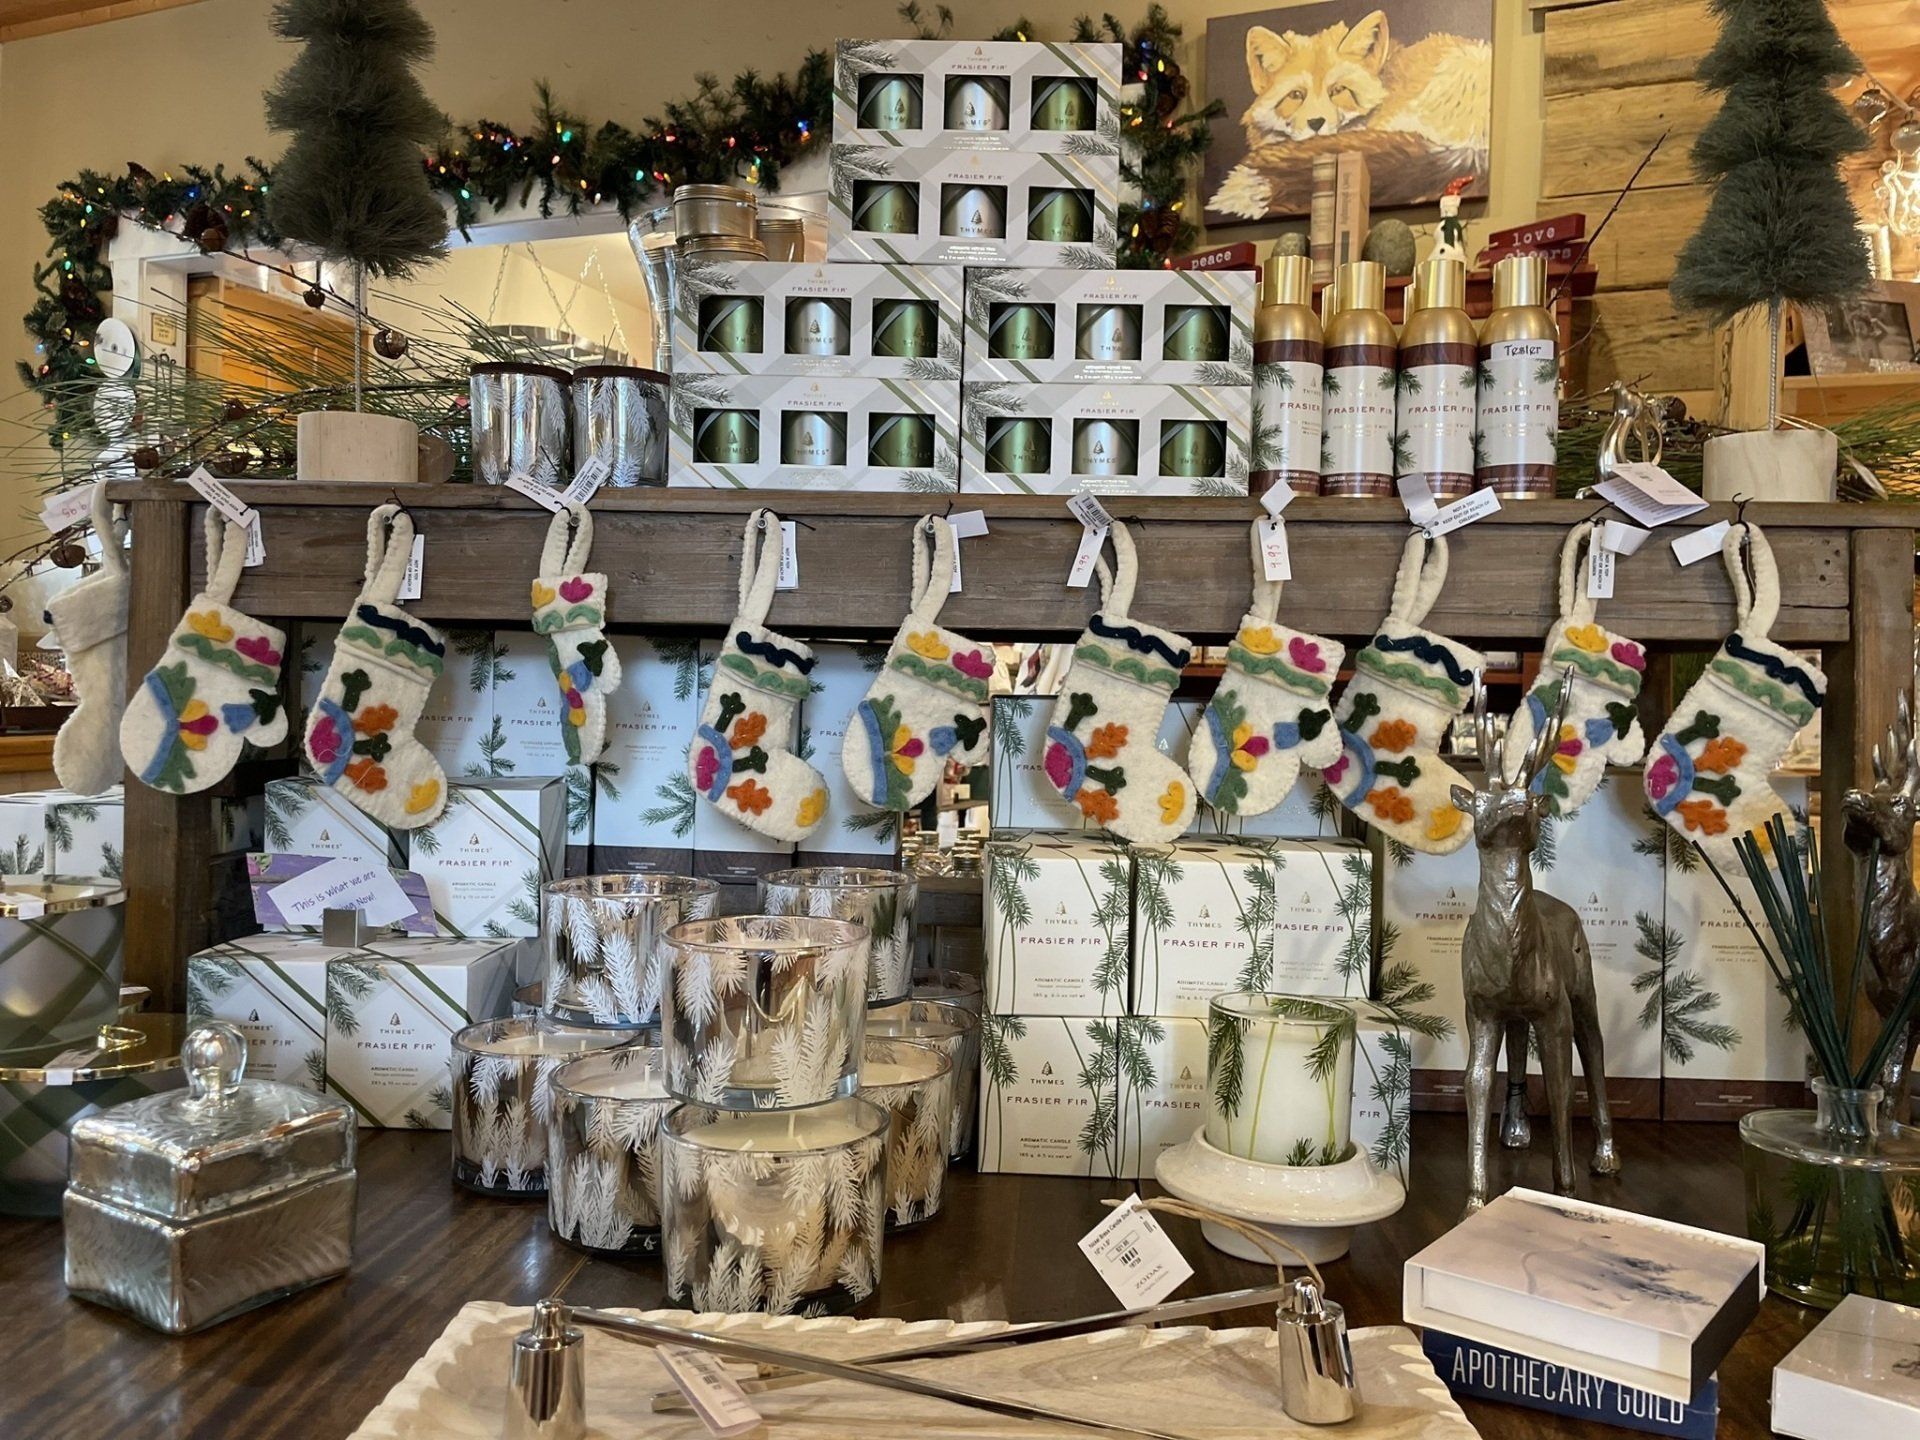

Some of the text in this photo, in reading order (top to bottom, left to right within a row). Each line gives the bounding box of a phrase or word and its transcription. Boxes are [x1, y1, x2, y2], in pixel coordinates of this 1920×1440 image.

[1512, 227, 1556, 248] love
[1192, 251, 1231, 270] peace
[1503, 344, 1542, 357] Tester
[1327, 406, 1393, 416] FRASIER FIR
[1408, 405, 1458, 415] FRASIER
[1482, 404, 1552, 416] FRASIER FIR
[1442, 516, 1453, 525] KEEP
[1453, 512, 1463, 520] OUT
[1469, 502, 1484, 514] REACH
[1452, 505, 1463, 514] NOT
[1458, 510, 1480, 526] CHILDREN
[511, 719, 552, 727] FRASIER
[1016, 764, 1042, 772] FRAS
[291, 895, 316, 915] This
[315, 893, 326, 903] is
[324, 879, 350, 899] what
[350, 875, 363, 888] we
[362, 869, 377, 883] are
[355, 890, 377, 908] Now!
[1275, 923, 1319, 932] RASIER
[1020, 936, 1101, 945] FRASIER FIR
[1163, 939, 1245, 949] FRASIER FIR
[357, 1041, 408, 1050] FRASIER
[1030, 1078, 1065, 1086] THYMES
[1006, 1096, 1088, 1106] FRASIER FIR
[1145, 1100, 1201, 1109] FRASIER
[1360, 1110, 1380, 1118] FIR
[1108, 1217, 1124, 1231] Candle
[1133, 1263, 1165, 1290] ZODAX
[1452, 1346, 1684, 1424] APOTHECARY GUILD
